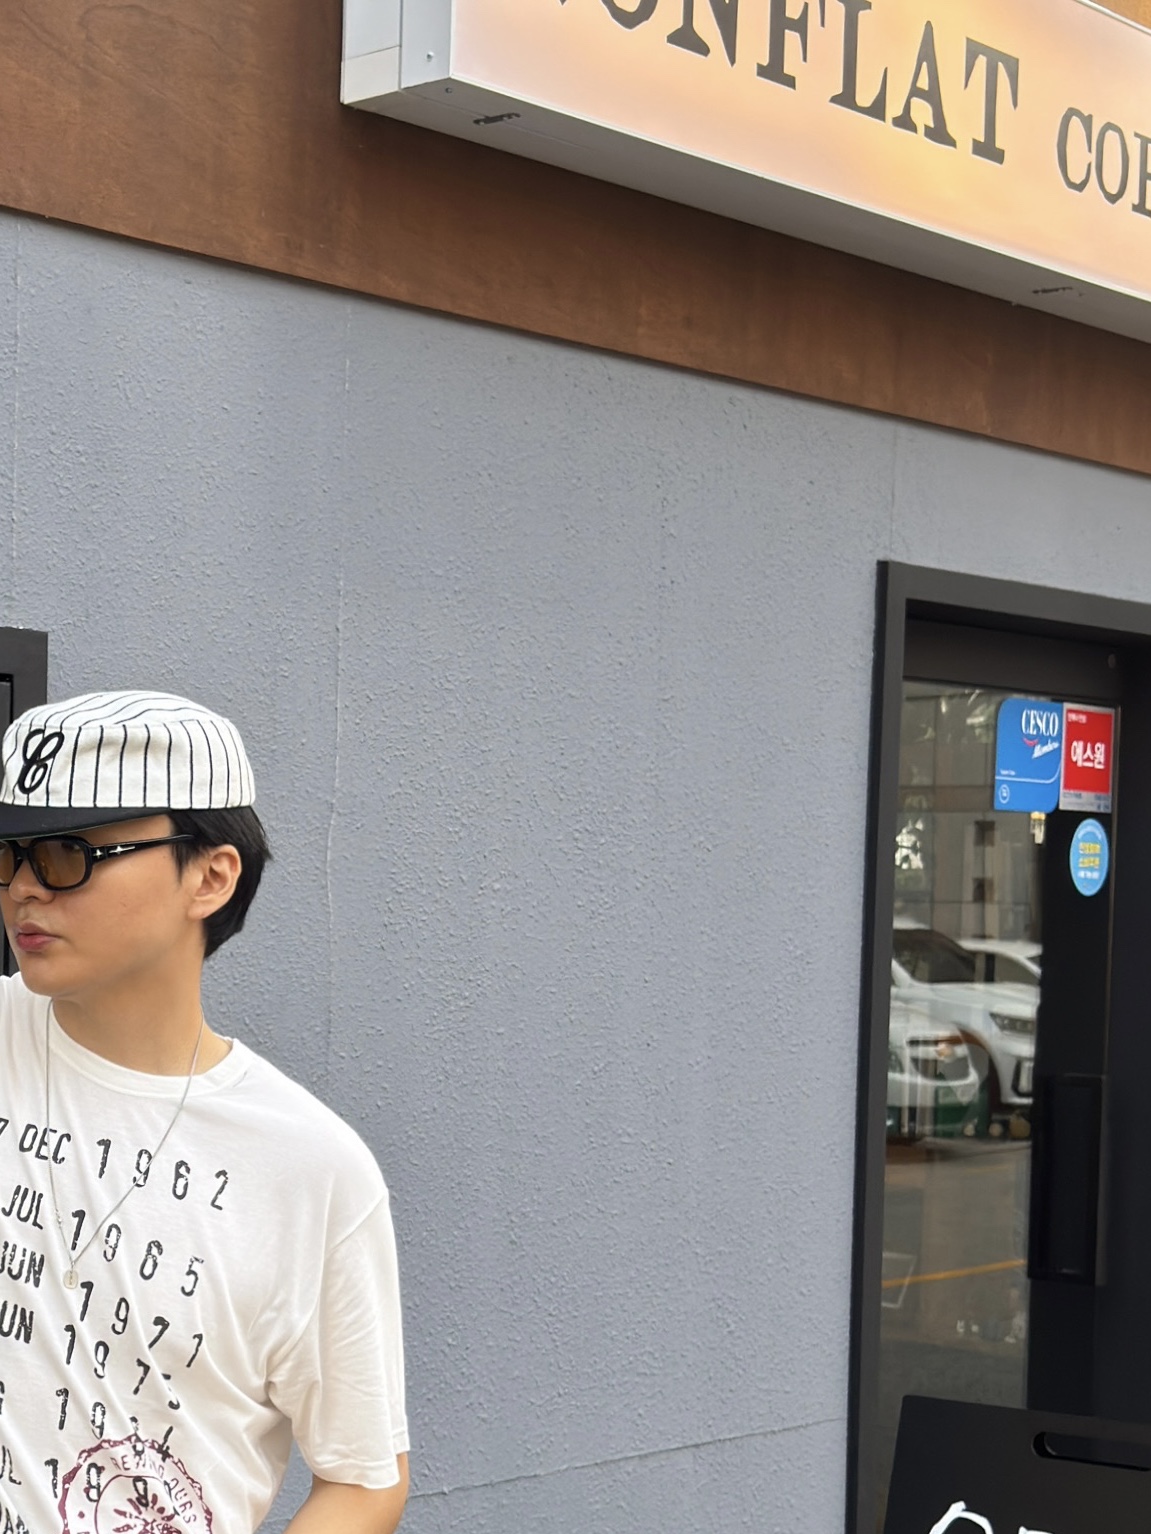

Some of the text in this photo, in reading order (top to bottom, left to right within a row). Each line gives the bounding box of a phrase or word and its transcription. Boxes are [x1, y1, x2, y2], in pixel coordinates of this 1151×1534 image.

[560, 0, 1020, 165] NFLAT
[1021, 709, 1059, 737] CESCO
[1071, 740, 1105, 769] 에스원
[18, 1123, 71, 1164] DEC
[1, 1185, 43, 1229] JUL
